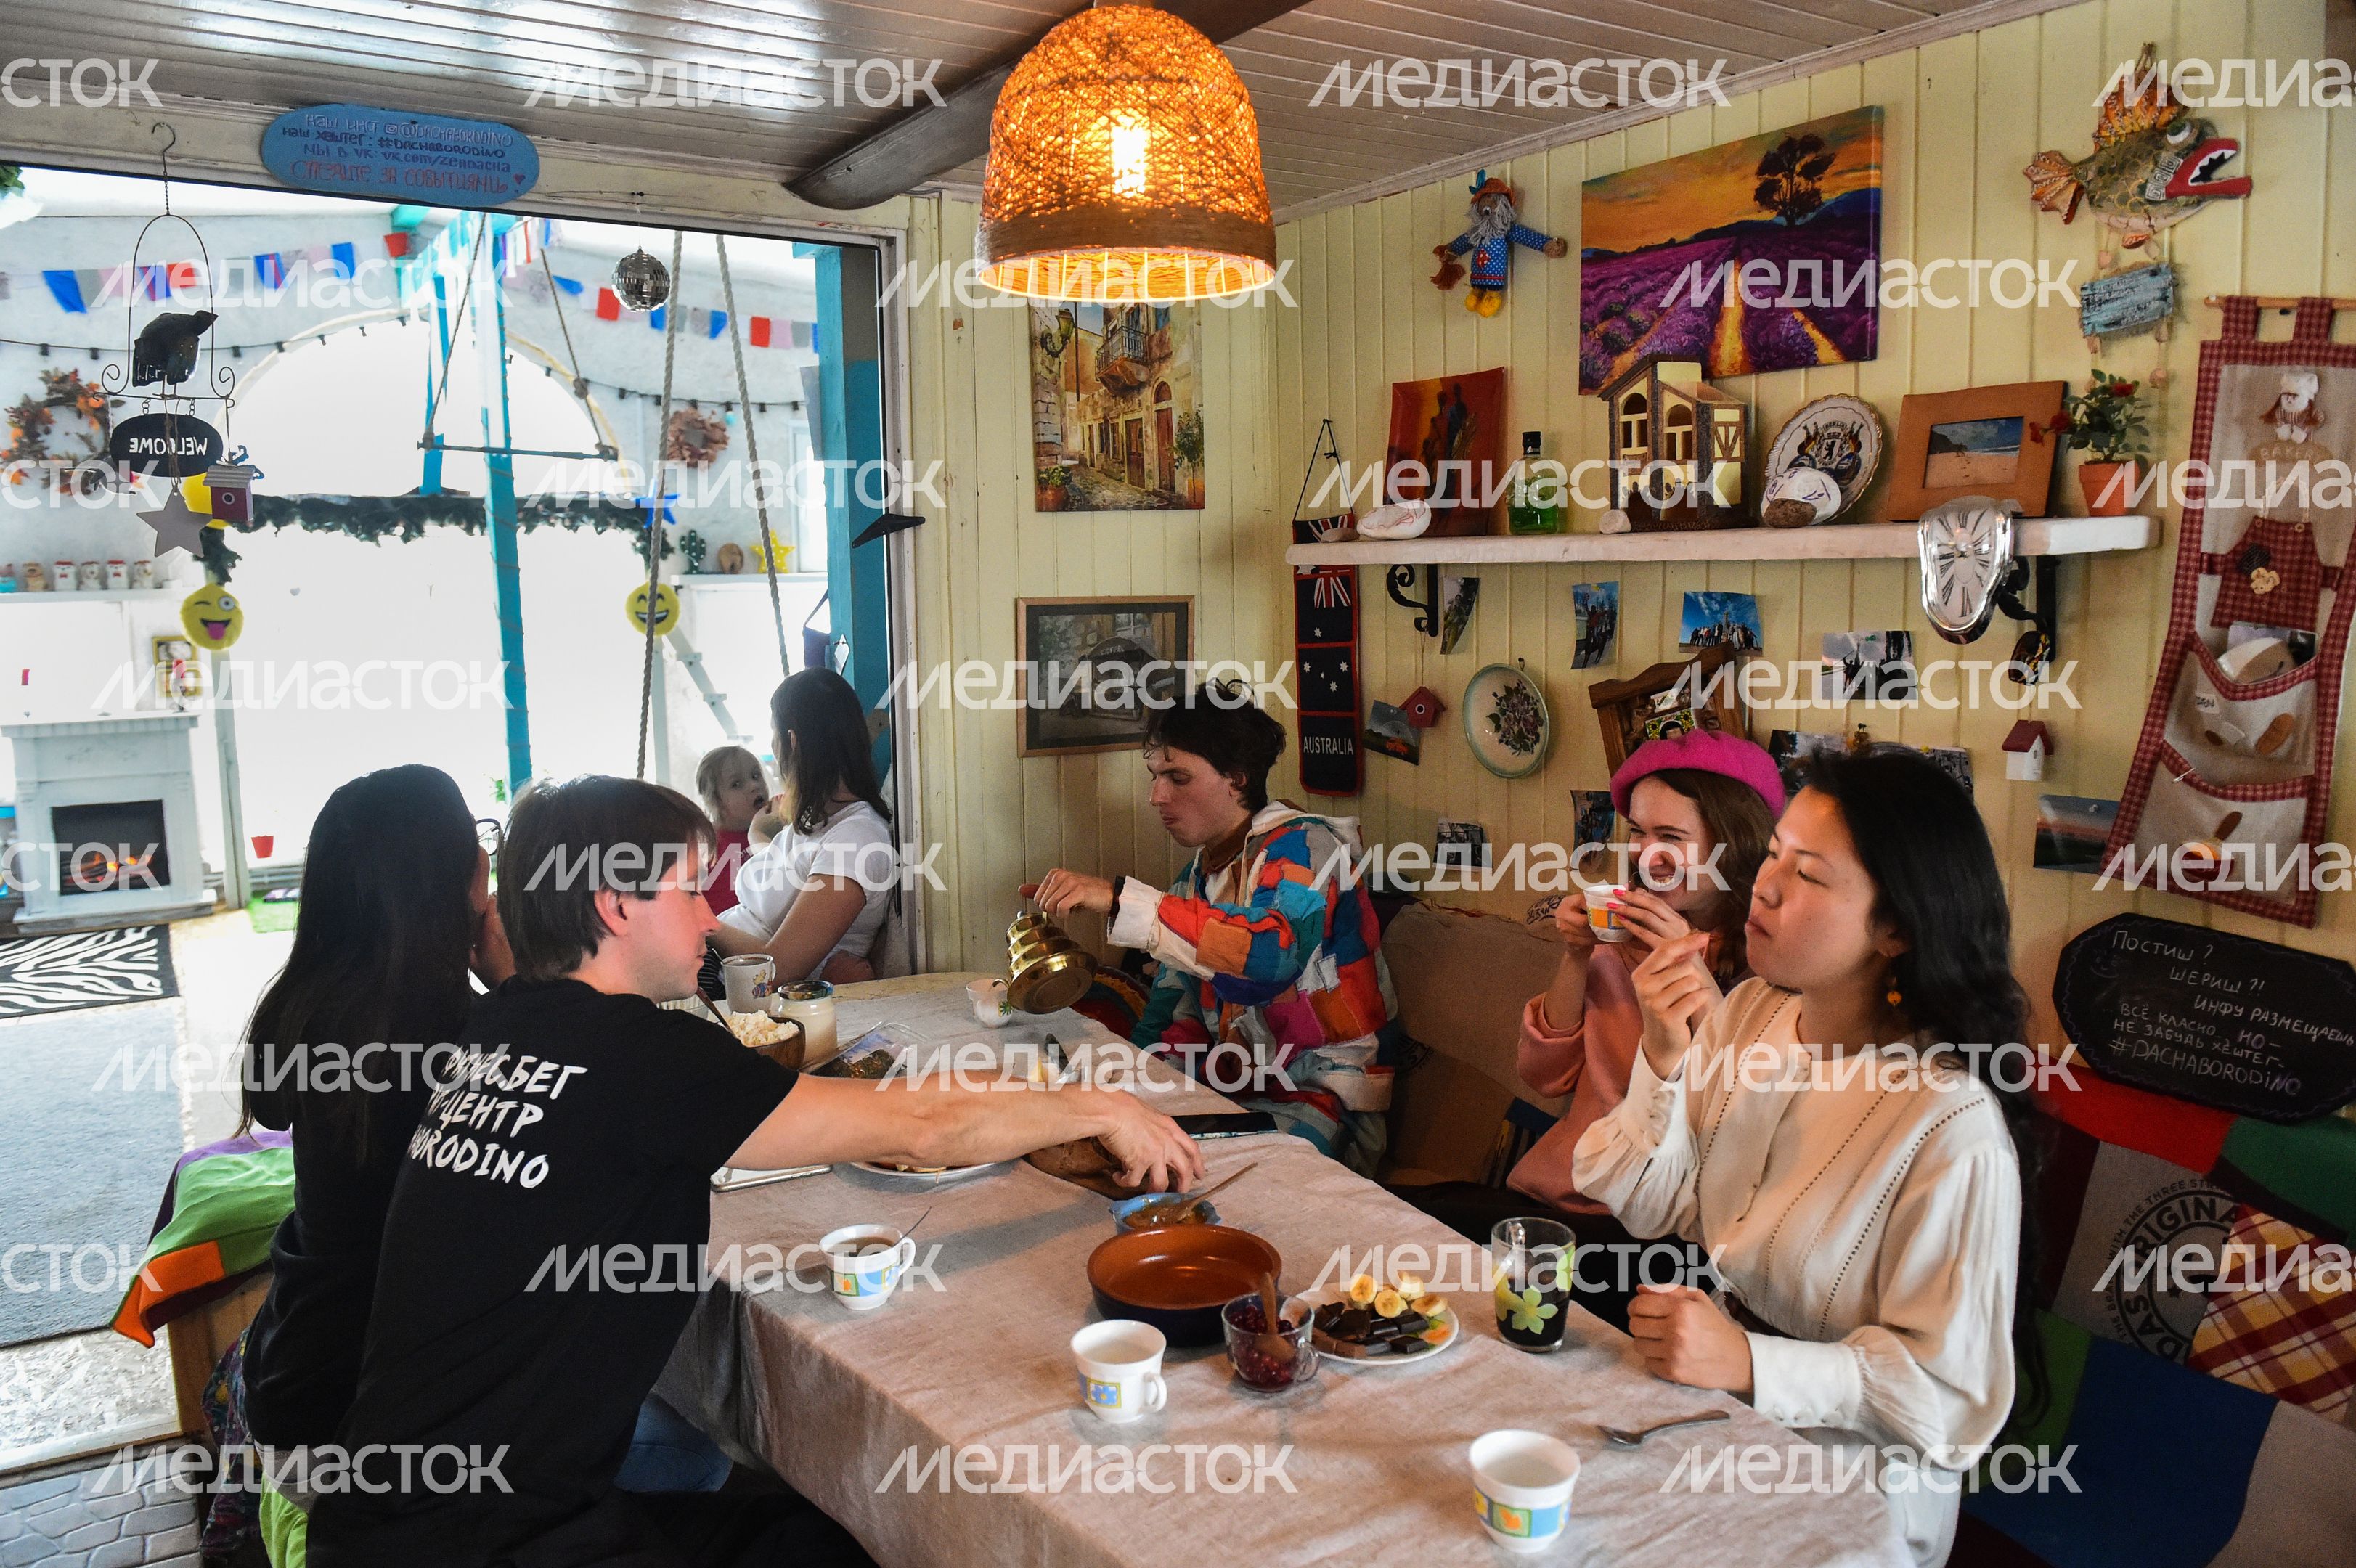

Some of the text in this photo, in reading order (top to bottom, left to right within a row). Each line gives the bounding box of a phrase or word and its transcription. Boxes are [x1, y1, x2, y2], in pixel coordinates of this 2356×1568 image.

[2260, 446, 2322, 461] BAKER
[1303, 735, 1354, 756] AUSTRALIA
[2114, 1018, 2138, 1034] НЕ
[2145, 1180, 2185, 1206] THREE
